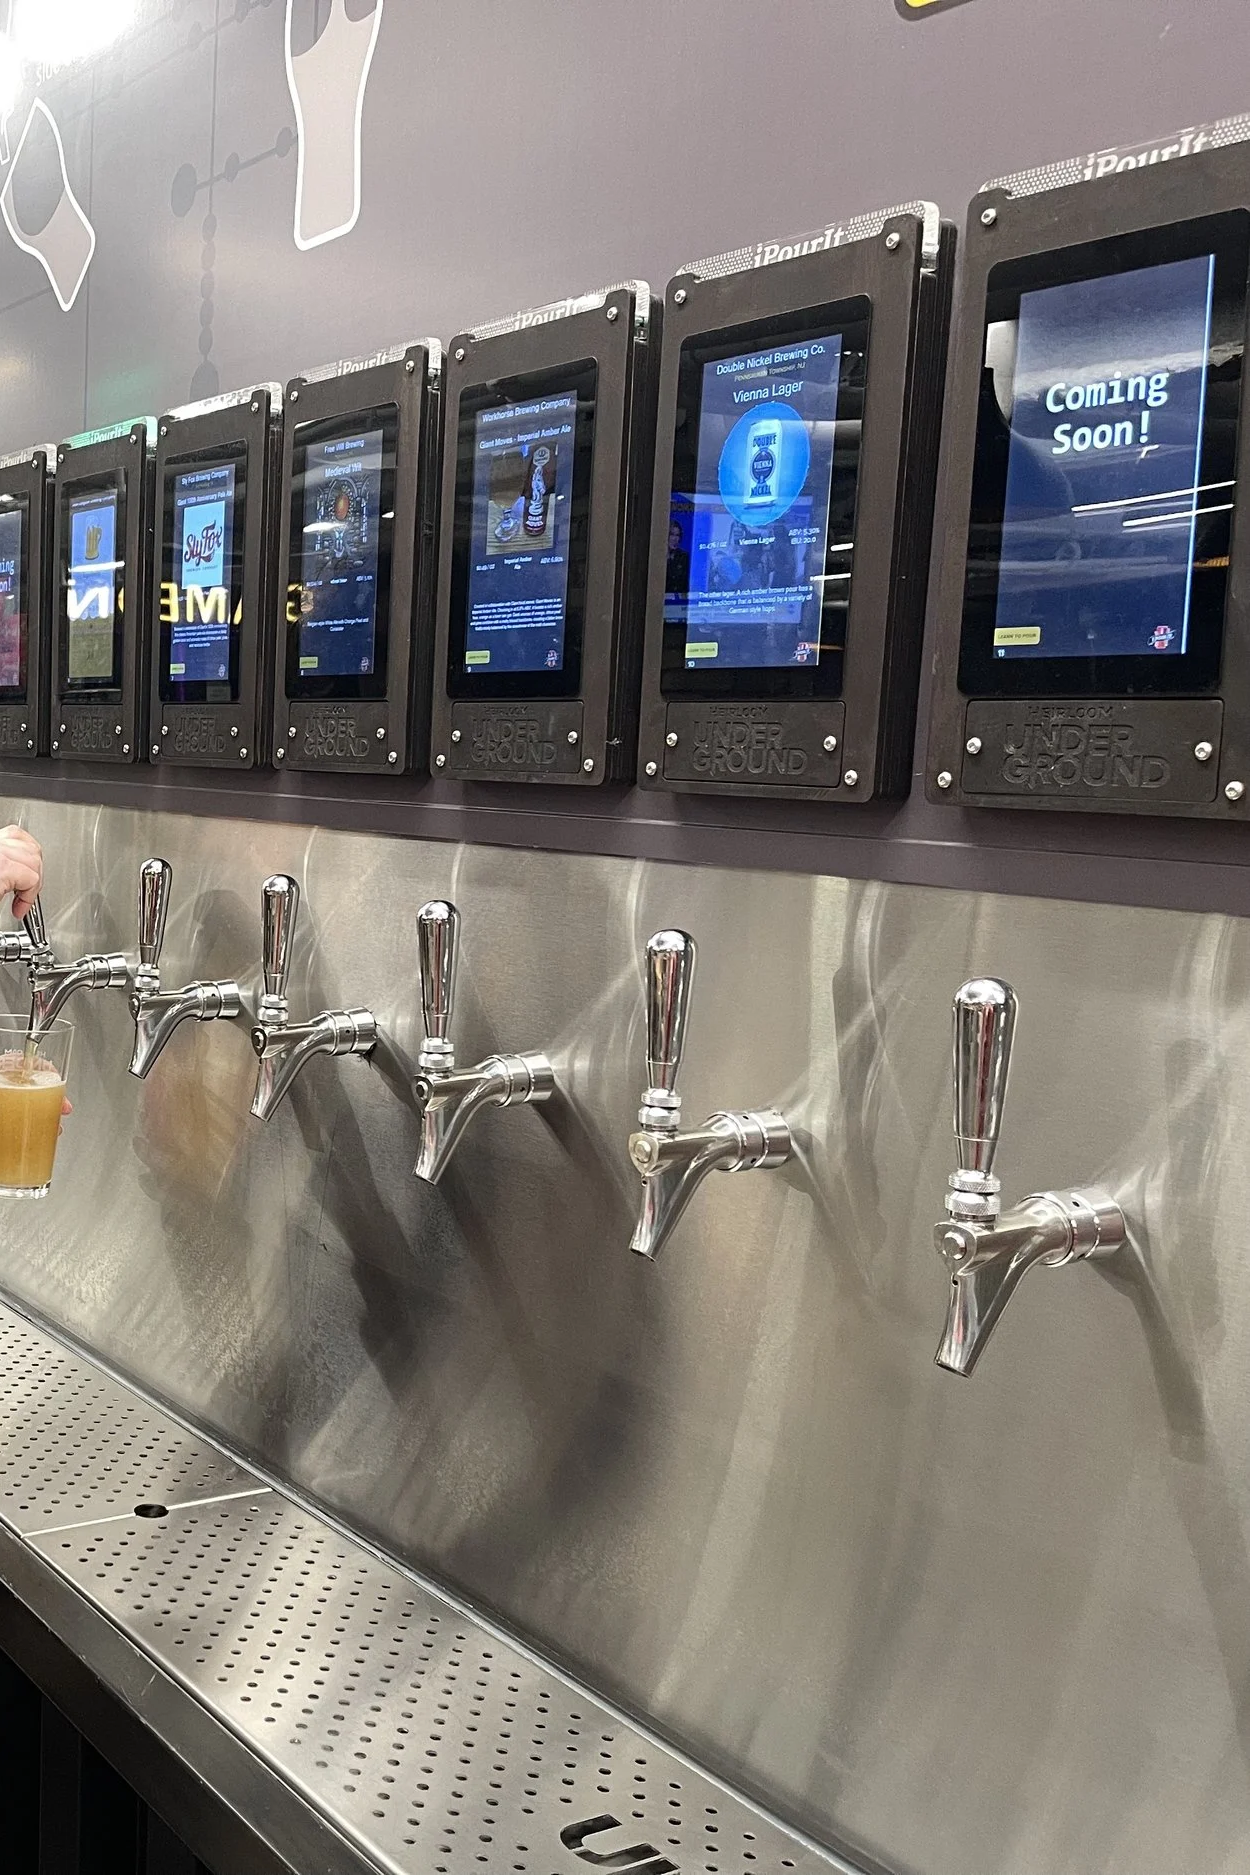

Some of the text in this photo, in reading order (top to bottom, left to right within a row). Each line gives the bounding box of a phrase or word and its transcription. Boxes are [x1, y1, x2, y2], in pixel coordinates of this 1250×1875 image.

[716, 344, 826, 375] Double Nickel Brewing Co.
[733, 381, 804, 403] Vienna Lager
[1046, 371, 1170, 413] Coming
[515, 403, 540, 416] Brewing
[541, 397, 571, 411] Company
[752, 434, 777, 448] DOUBLE
[1052, 411, 1150, 455] Soon!
[305, 716, 357, 738] UNDER
[472, 718, 541, 743] UNDER
[693, 721, 784, 750] UNDER
[1003, 723, 1135, 756] UNDER
[304, 735, 370, 758] GROUND
[470, 740, 555, 765] GROUND
[692, 747, 808, 776] GROUND
[1001, 753, 1171, 790] GROUND
